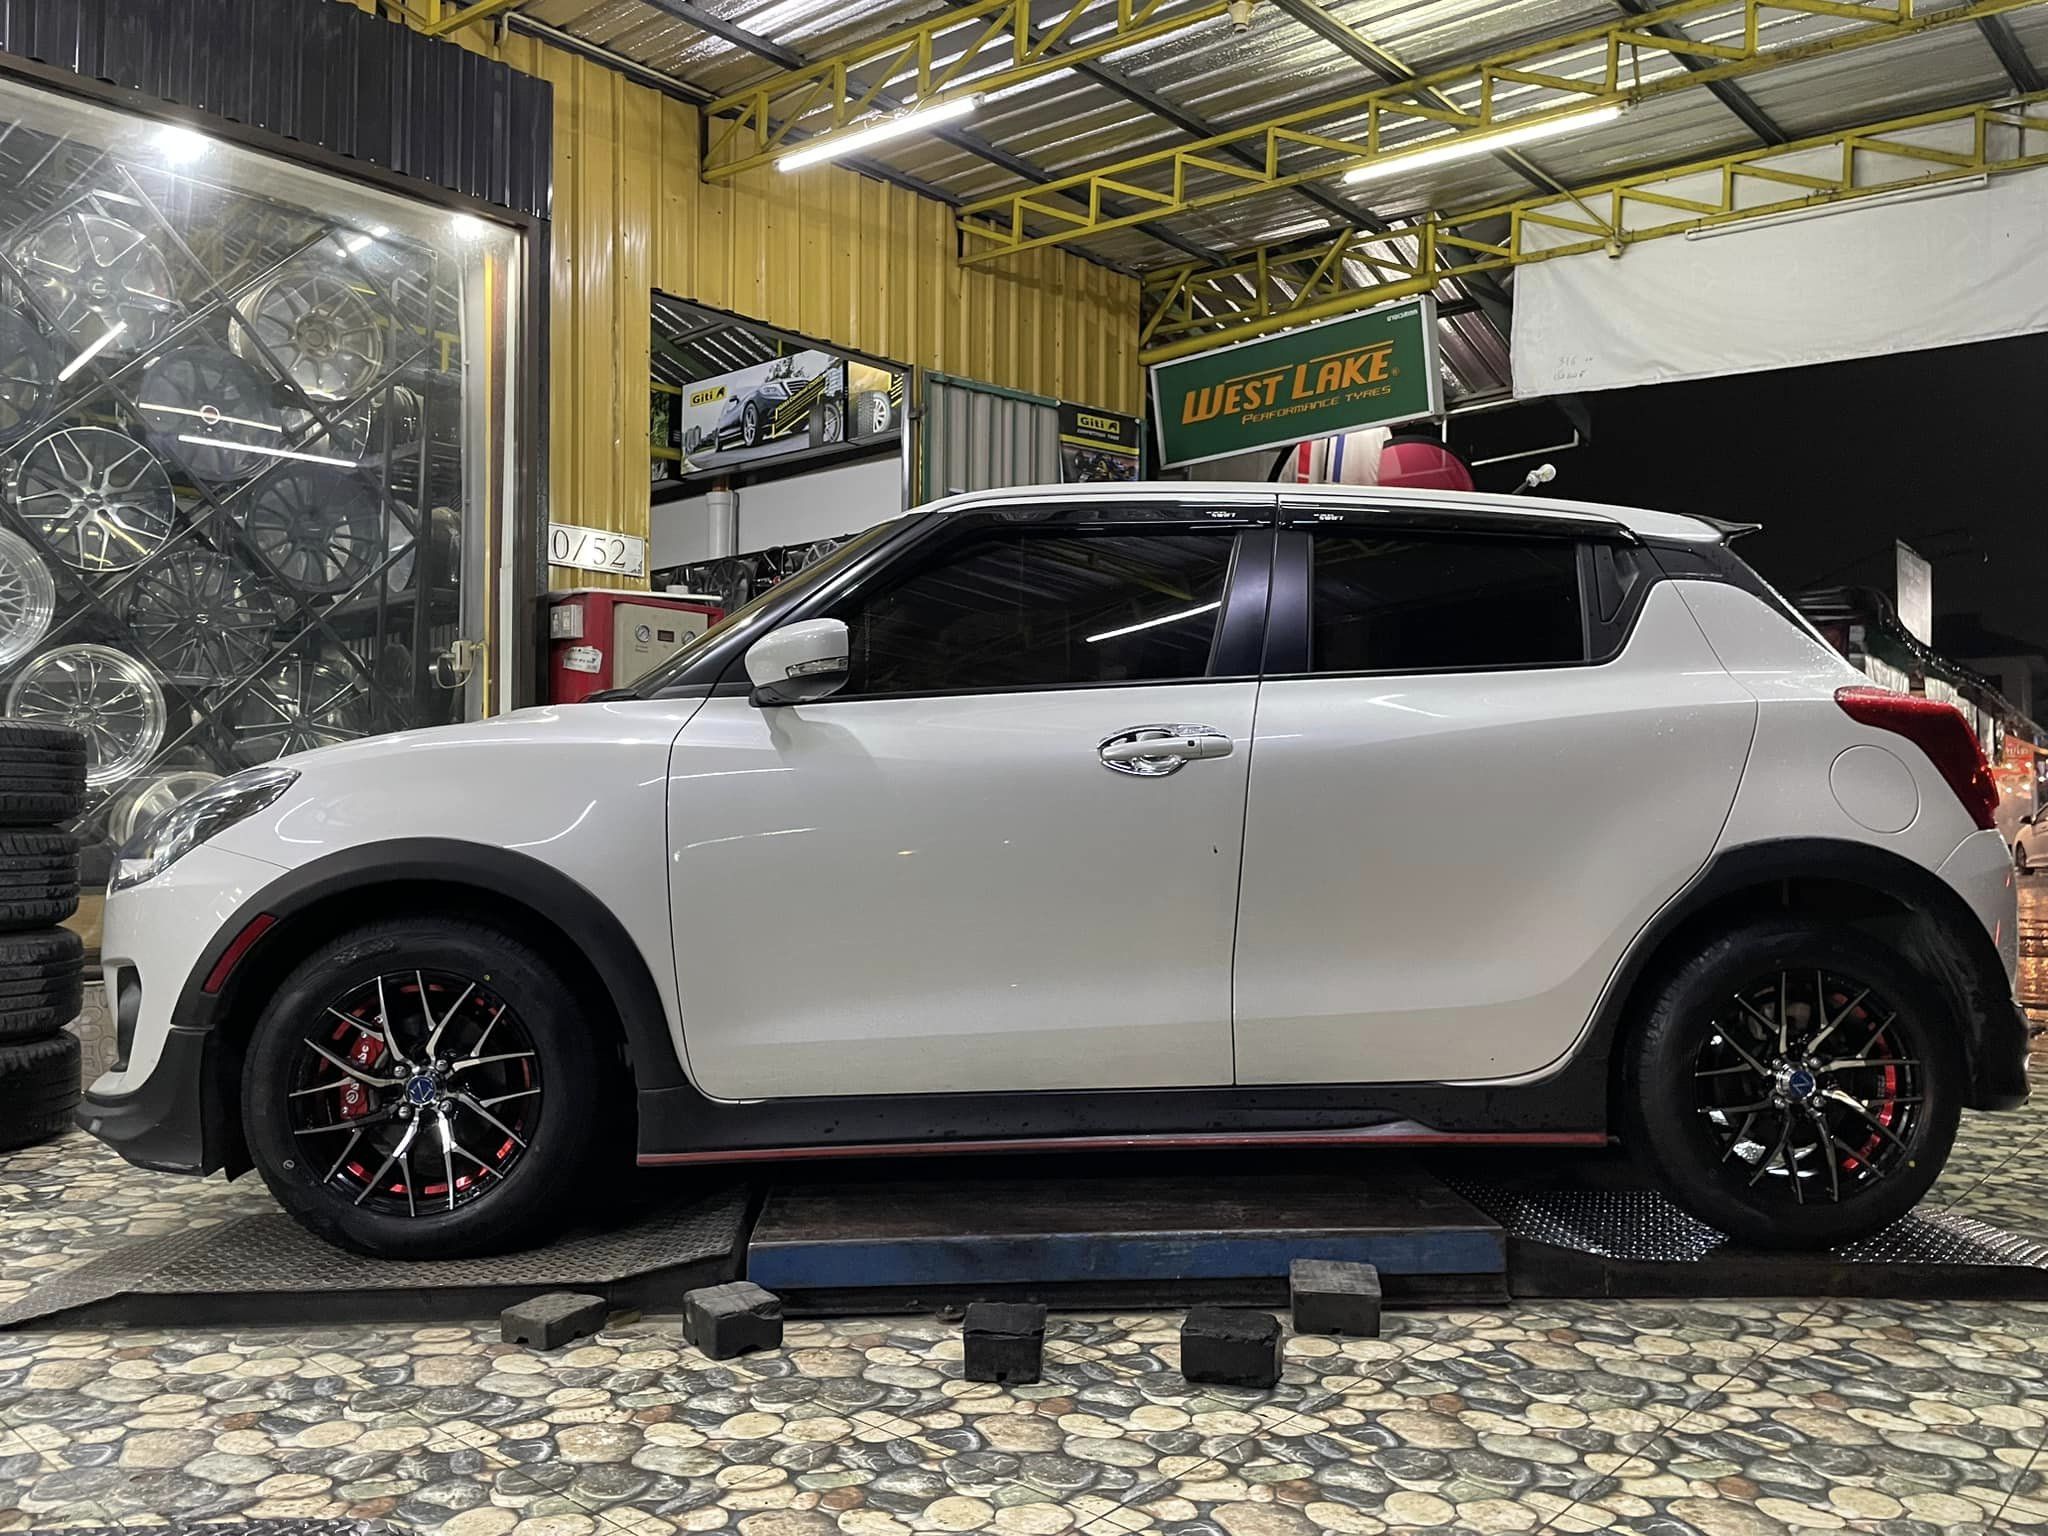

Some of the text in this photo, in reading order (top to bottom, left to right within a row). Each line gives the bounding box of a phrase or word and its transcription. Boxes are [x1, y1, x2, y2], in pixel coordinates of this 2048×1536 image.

[692, 390, 714, 406] Giti
[1181, 347, 1393, 425] WEST LAKE
[1241, 385, 1391, 425] PERFORMANCE TYRES
[1080, 416, 1105, 429] Giti
[552, 529, 626, 568] 0/52
